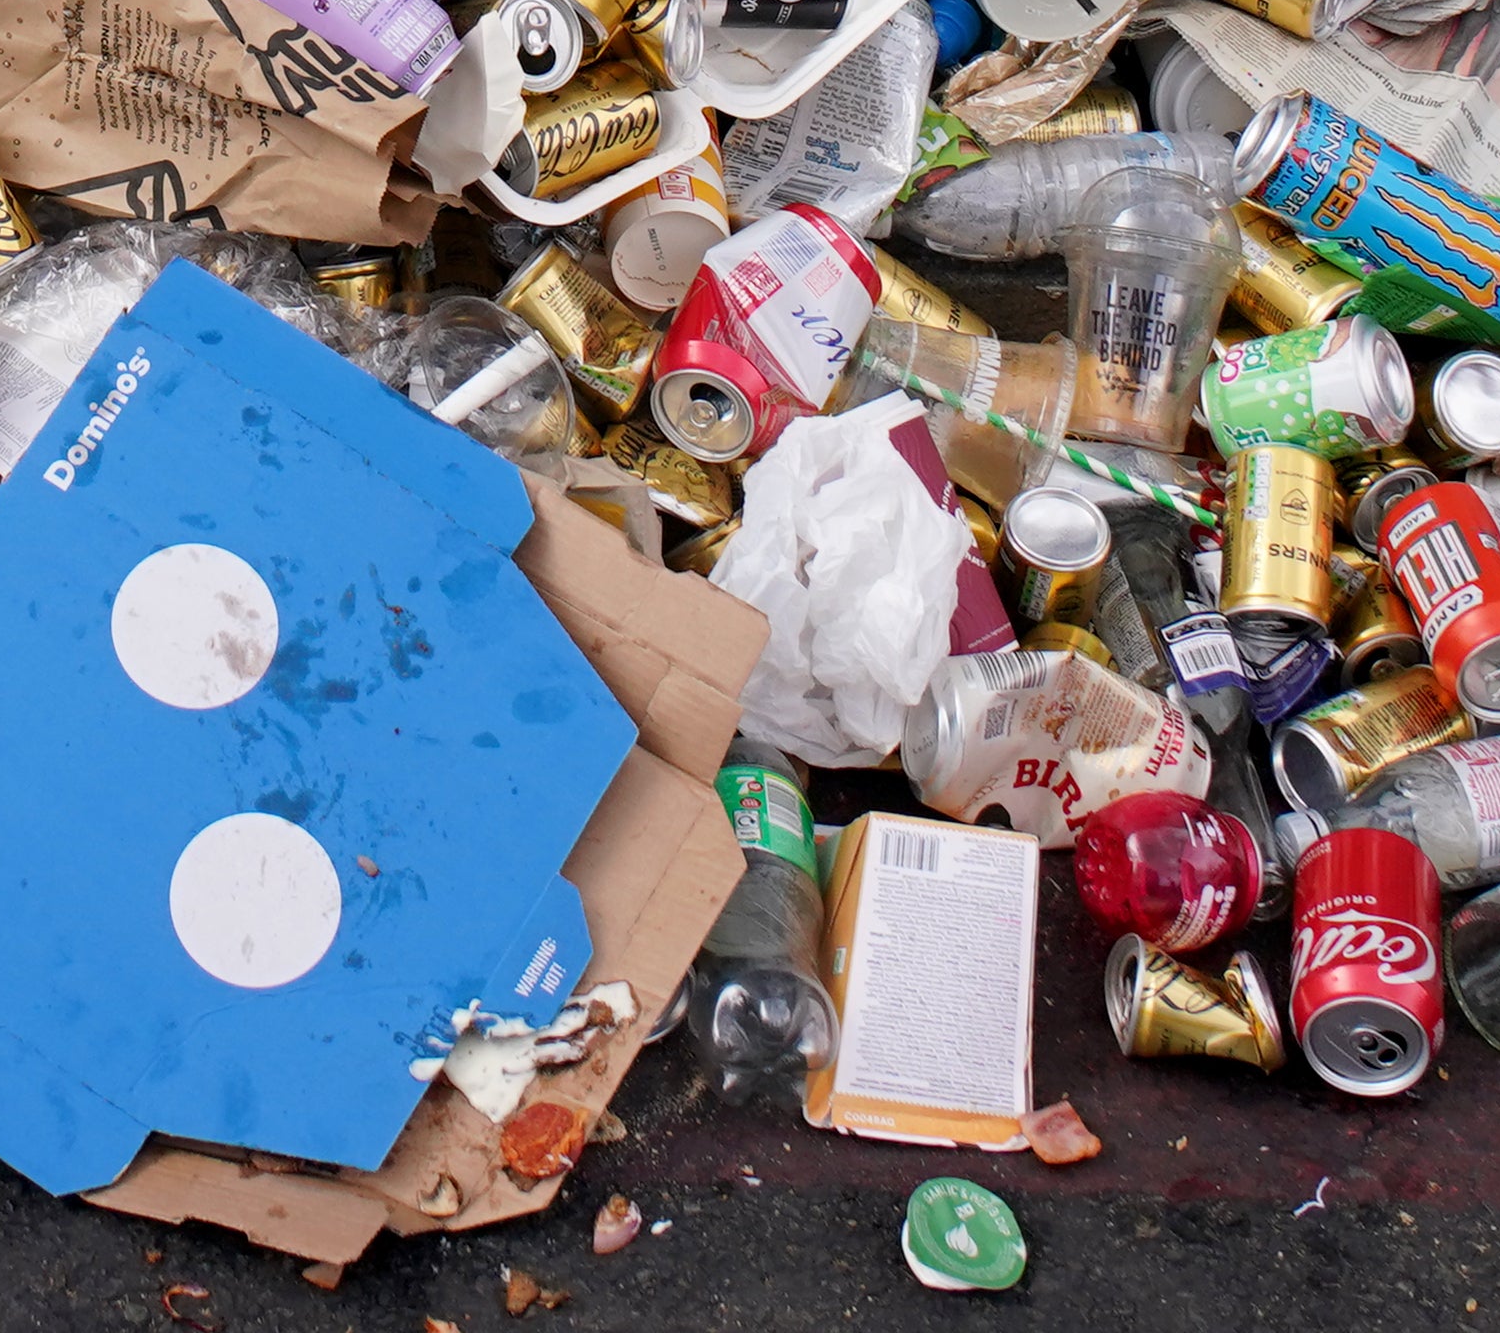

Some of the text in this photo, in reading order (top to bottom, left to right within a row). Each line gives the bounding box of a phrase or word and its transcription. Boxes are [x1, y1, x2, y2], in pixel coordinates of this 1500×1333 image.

[1312, 126, 1381, 232] JUICED
[1106, 285, 1166, 310] LEAVE
[1094, 311, 1178, 347] THE HERD
[1100, 341, 1161, 372] BEHIND
[43, 349, 151, 492] Domino's
[1392, 508, 1432, 542] LAGER
[1164, 707, 1186, 767] BIRRA
[514, 937, 559, 998] WARNING:
[540, 961, 568, 996] HOT!
